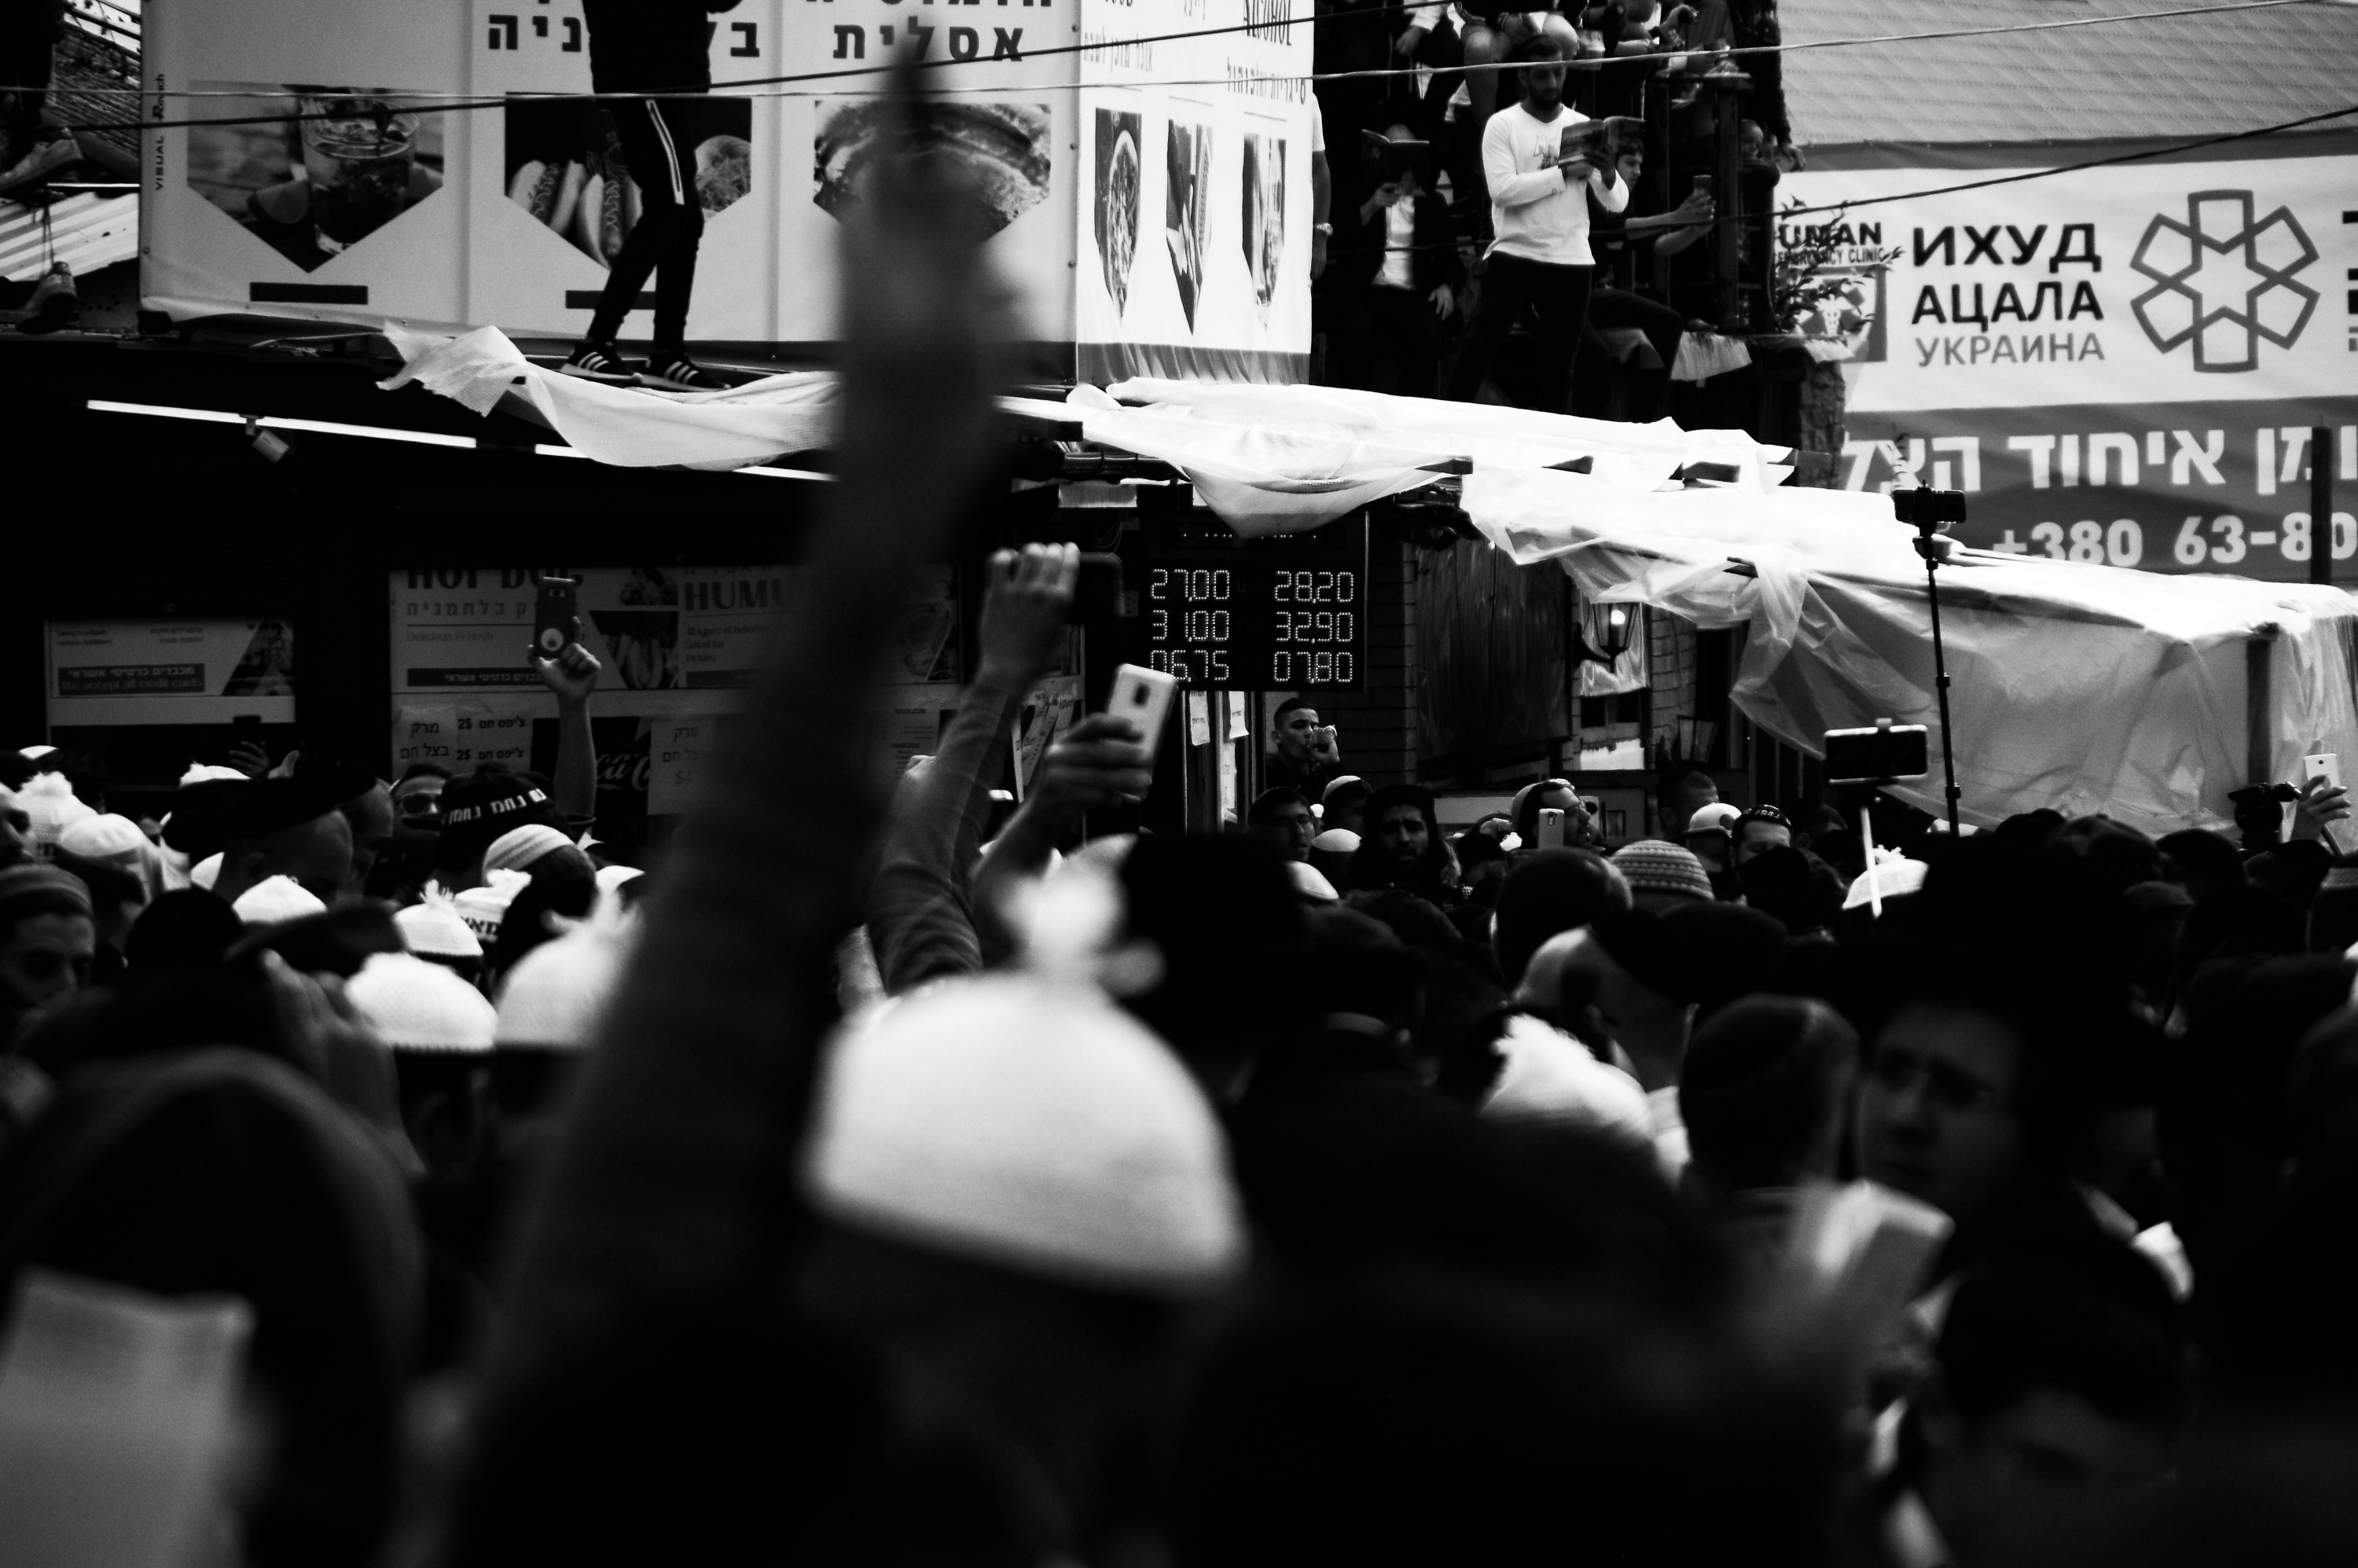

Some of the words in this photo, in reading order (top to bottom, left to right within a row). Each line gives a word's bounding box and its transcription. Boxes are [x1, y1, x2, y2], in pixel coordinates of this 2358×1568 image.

[833, 16, 1023, 62] אסלית
[1778, 222, 1882, 249] UMAN
[1912, 222, 2102, 273] ИХУД
[1849, 247, 1884, 263] CLINIC
[1912, 281, 2104, 332] АЦАЛА
[1915, 332, 2105, 368] УКРАИНА
[2007, 429, 2226, 489] איחוד
[1993, 517, 2144, 568] +380
[1274, 571, 1353, 604] 28.20
[406, 598, 505, 616] בלחמניה
[1274, 611, 1353, 644] 32.90
[513, 673, 542, 682] כבדים
[1273, 651, 1353, 684] 07.80
[411, 722, 439, 737] מרק
[479, 719, 495, 729] חם
[400, 747, 418, 759] חם
[423, 744, 449, 756] בצל
[478, 751, 494, 760] חם
